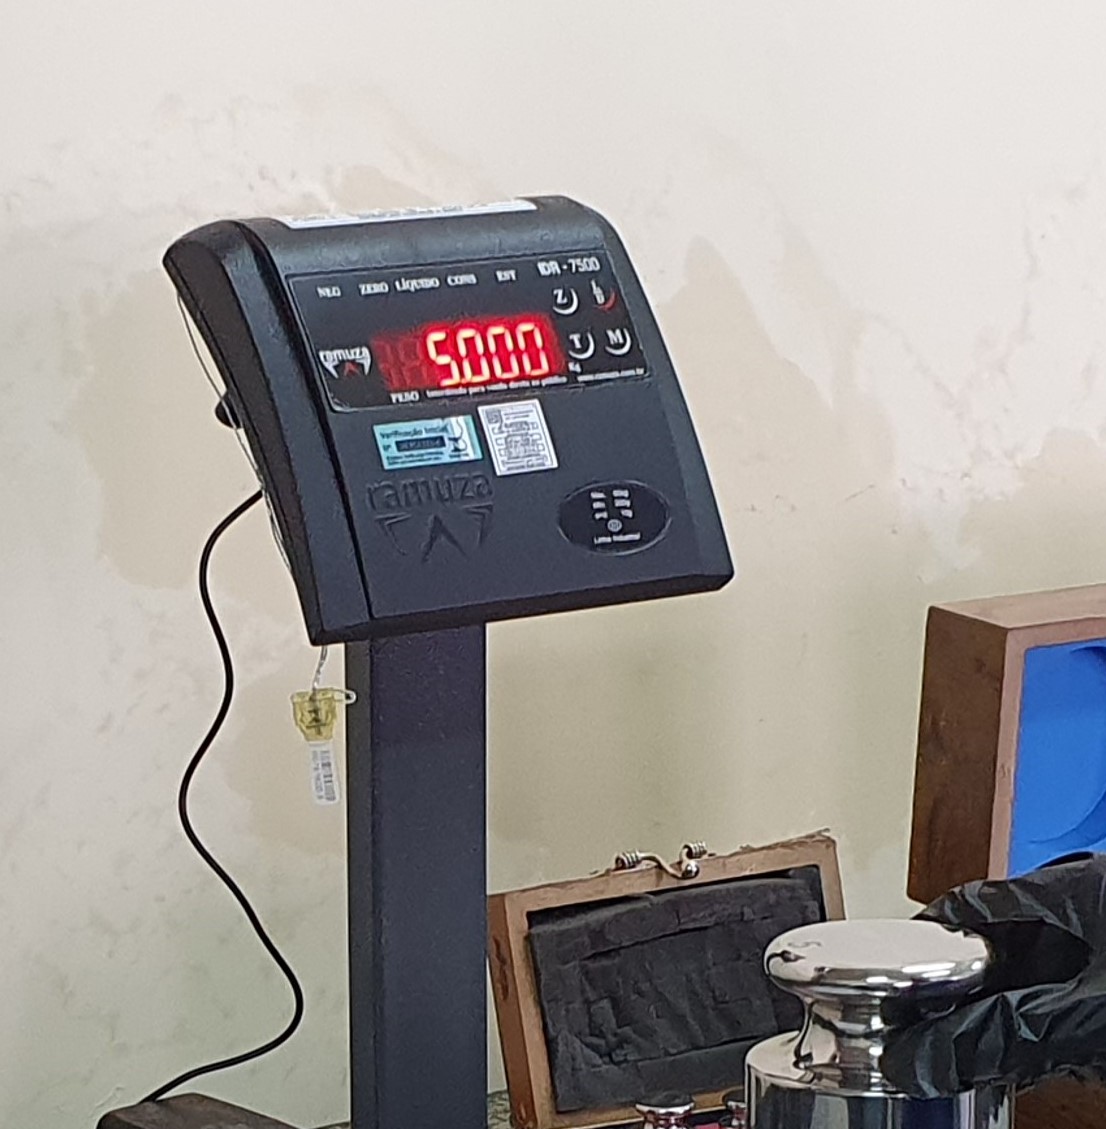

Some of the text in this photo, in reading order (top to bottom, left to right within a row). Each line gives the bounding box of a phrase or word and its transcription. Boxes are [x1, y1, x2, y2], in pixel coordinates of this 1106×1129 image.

[358, 281, 389, 296] ZERO
[569, 333, 582, 348] T
[607, 328, 624, 345] M
[366, 473, 494, 511] ramuza
